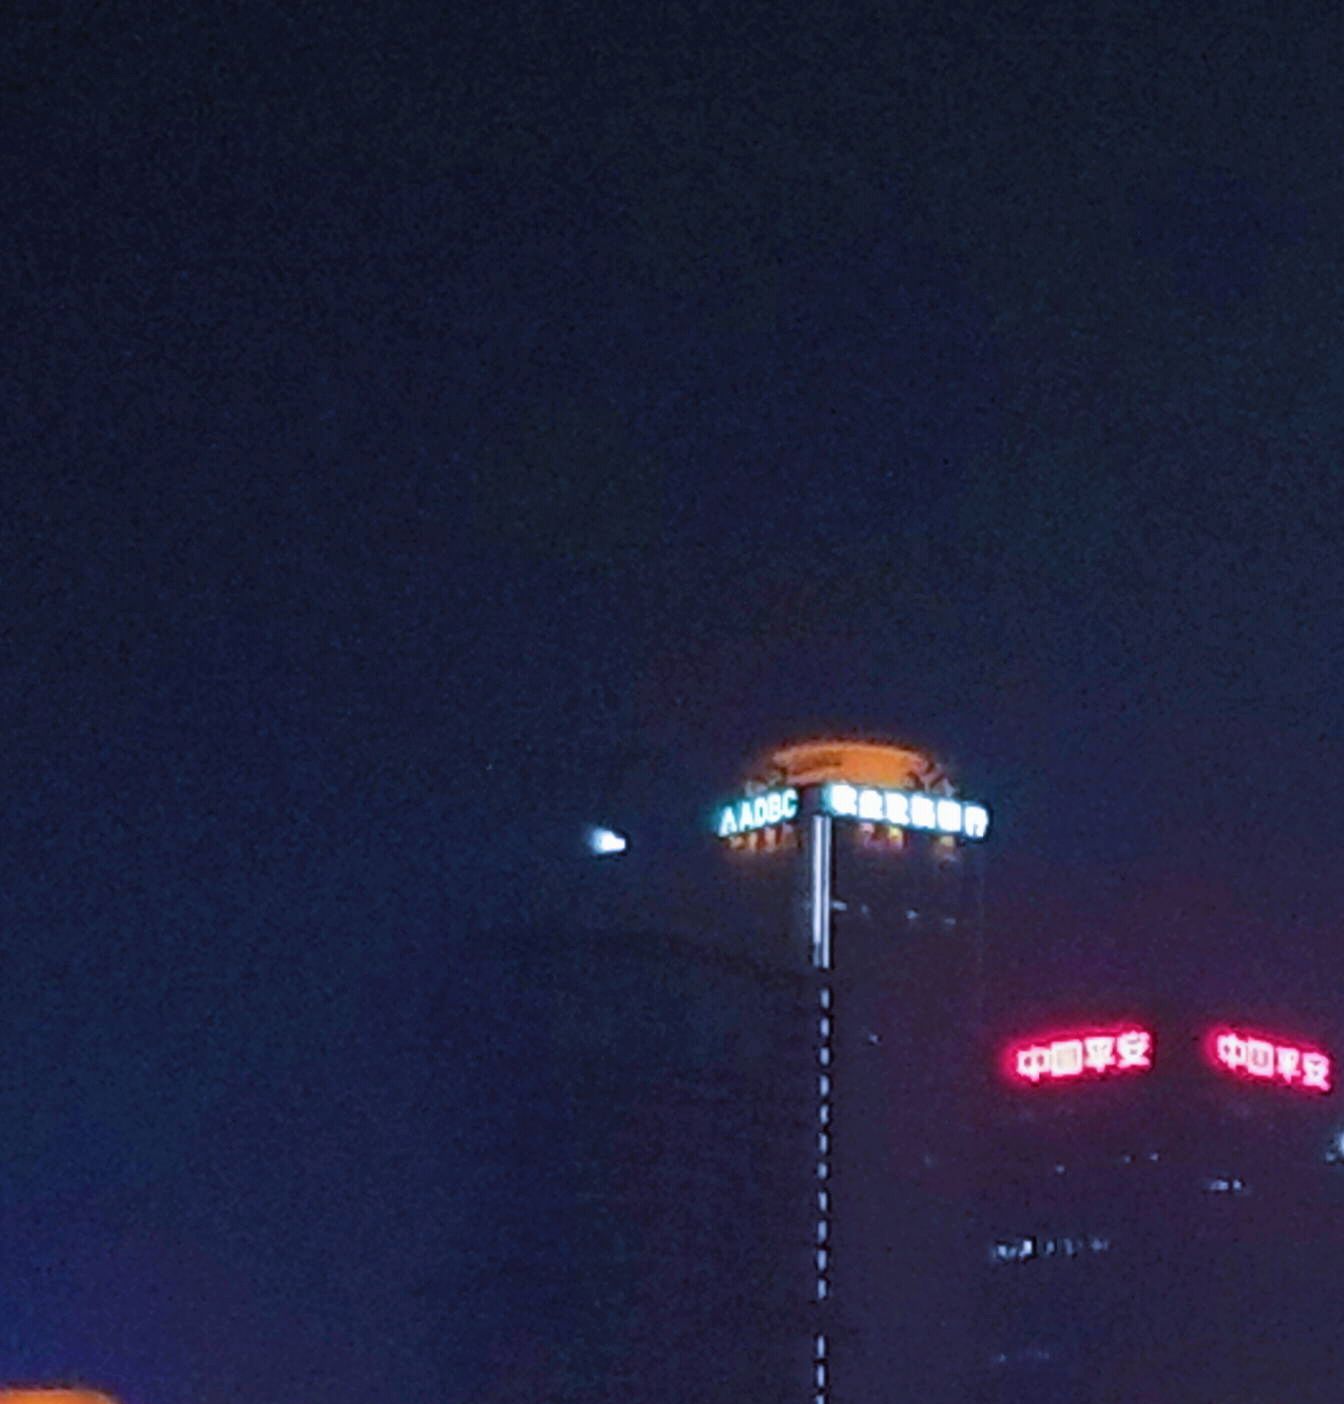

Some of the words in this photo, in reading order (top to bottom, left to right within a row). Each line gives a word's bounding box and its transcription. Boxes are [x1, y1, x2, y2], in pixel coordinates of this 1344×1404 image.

[1016, 1030, 1151, 1082] 中国平安
[1216, 1032, 1332, 1093] 中国平安
